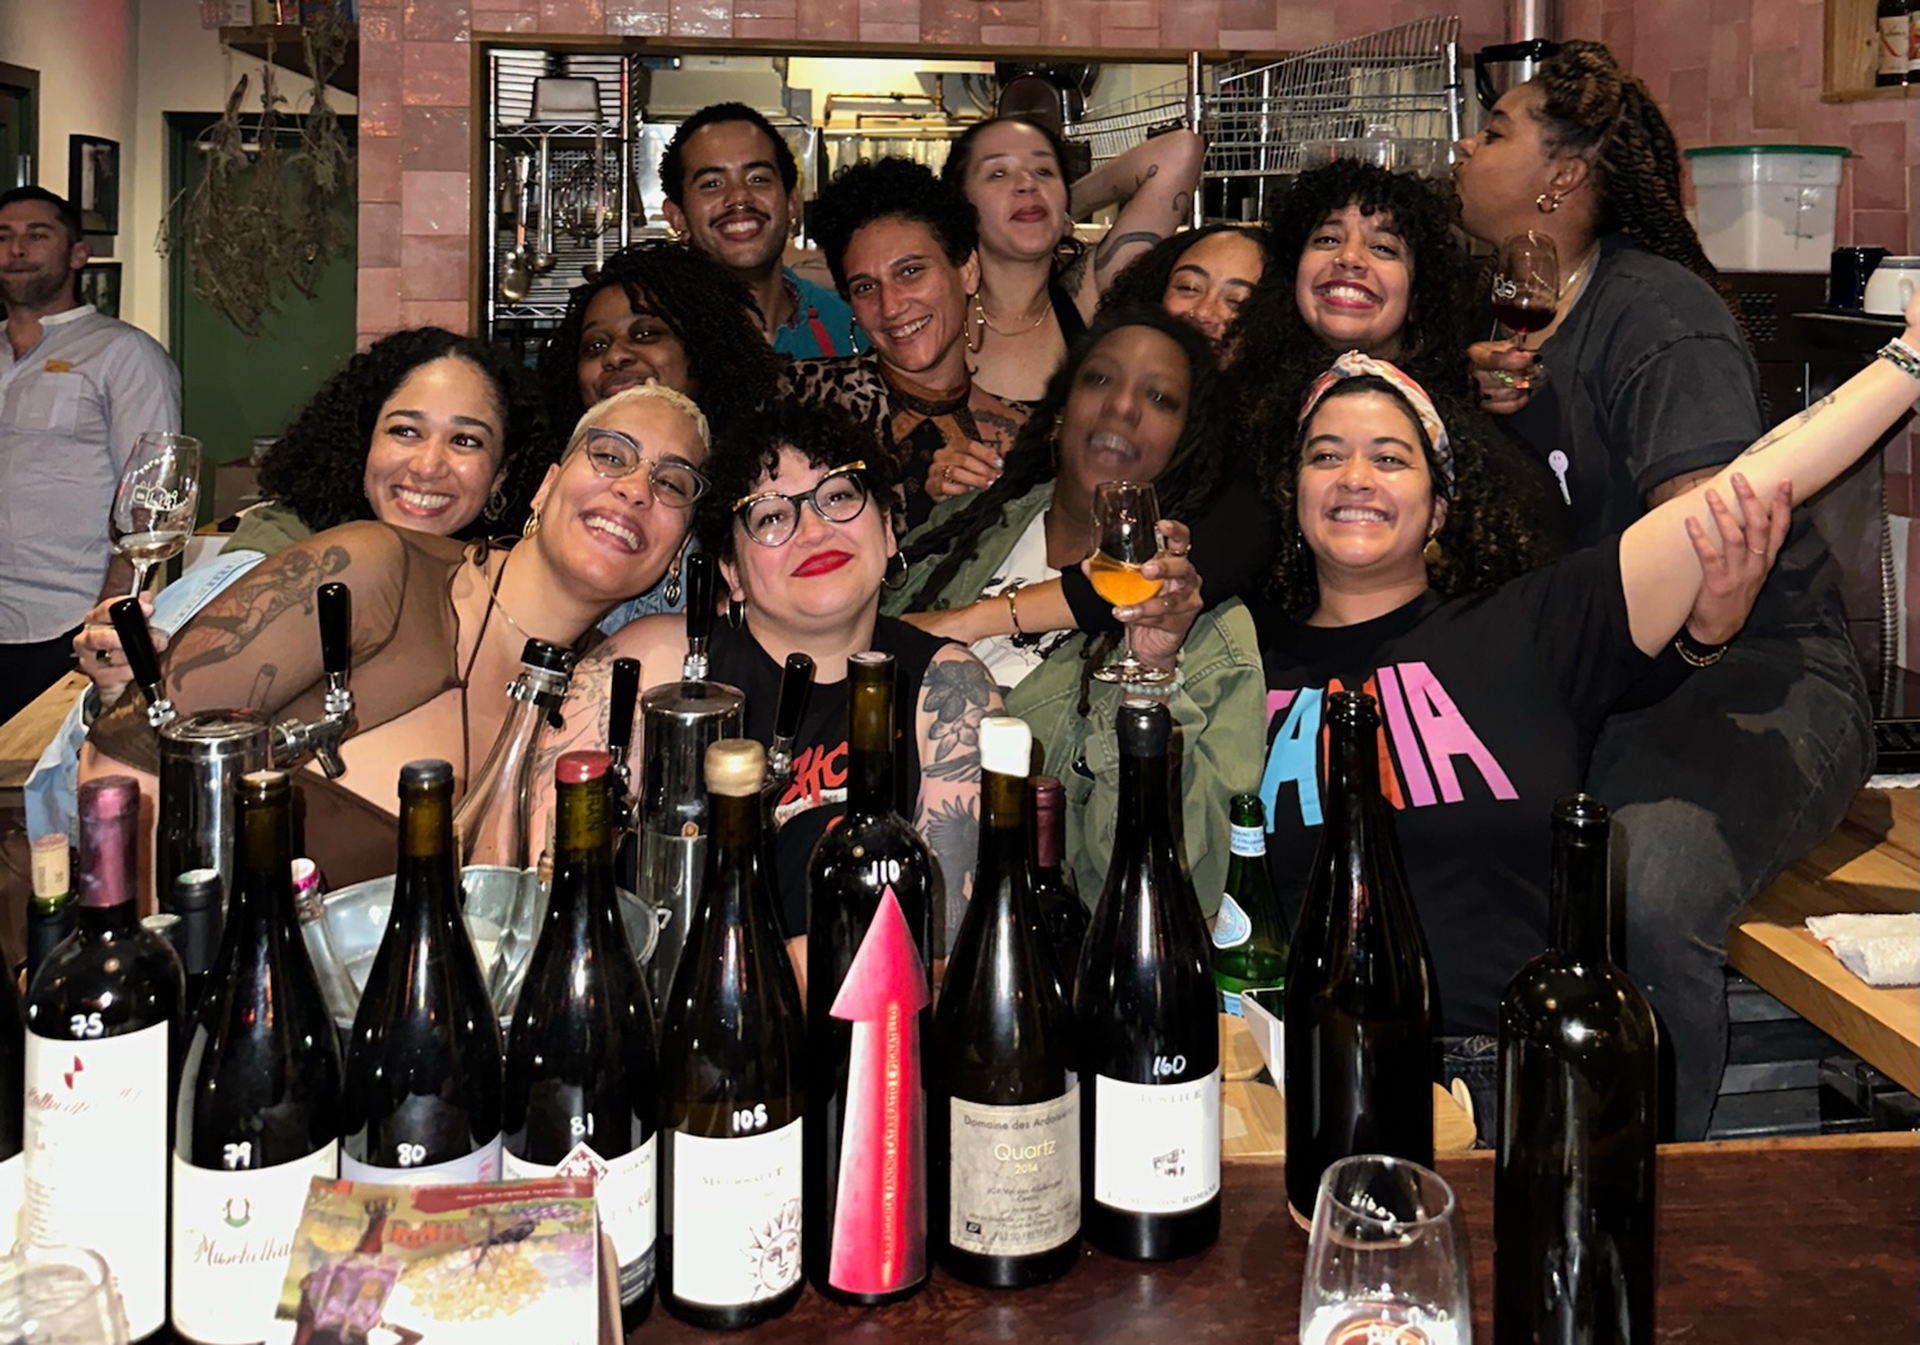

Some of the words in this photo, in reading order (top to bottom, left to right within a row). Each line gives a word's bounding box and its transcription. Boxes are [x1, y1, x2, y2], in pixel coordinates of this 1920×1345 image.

[1261, 661, 1520, 833] TAIA
[70, 1014, 104, 1036] 75
[1152, 1055, 1186, 1077] 160
[569, 1113, 595, 1137] 81
[732, 1104, 768, 1132] 105
[963, 1113, 1009, 1131] Domaine
[1012, 1118, 1030, 1130] des
[223, 1142, 252, 1168] 79
[397, 1143, 426, 1166] 80
[994, 1138, 1056, 1162] Quartz
[1014, 1163, 1039, 1175] 2014
